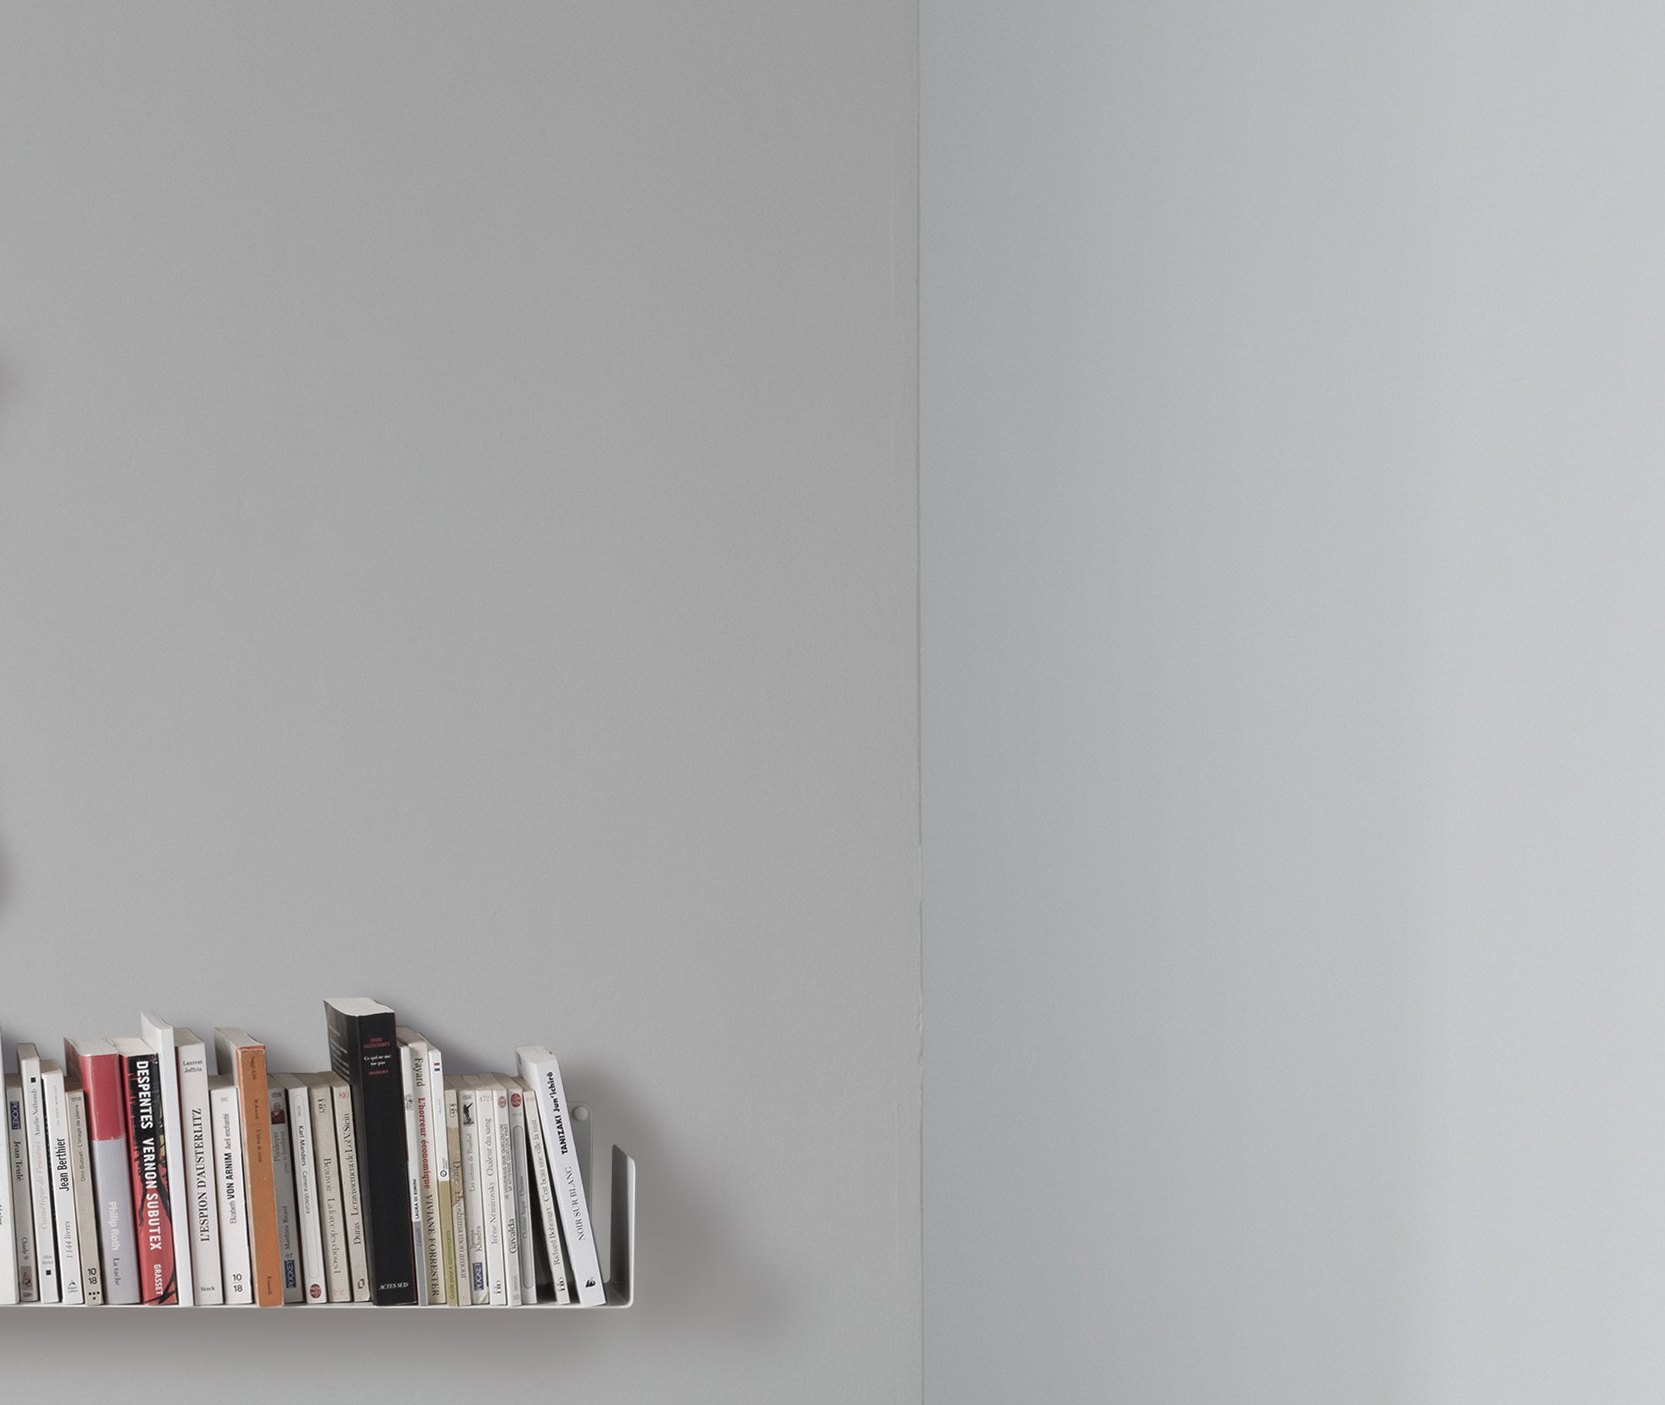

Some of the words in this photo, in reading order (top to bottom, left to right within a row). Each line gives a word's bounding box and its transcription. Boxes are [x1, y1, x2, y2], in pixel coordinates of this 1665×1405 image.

[413, 1057, 426, 1087] Fayard
[136, 1061, 153, 1129] DESPENTES
[417, 1097, 429, 1137] L'horreur
[192, 1108, 206, 1188] D'AUSTERLITZ
[555, 1114, 568, 1155] TANIZAKI
[13, 1141, 21, 1159] Jean
[55, 1137, 69, 1171] Berthier
[143, 1137, 157, 1189] VERNON
[419, 1139, 432, 1190] économique
[224, 1152, 234, 1180] ARNIM
[59, 1172, 70, 1192] Jean
[226, 1182, 235, 1200] VON
[108, 1201, 119, 1227] Philip
[146, 1193, 162, 1251] SUBUTEX
[571, 1198, 580, 1217] SUR
[110, 1228, 120, 1251] Roth
[508, 1218, 518, 1254] Gavalda
[575, 1218, 584, 1241] NOIR
[87, 1268, 97, 1276] 10
[88, 1276, 98, 1285] 18
[153, 1264, 164, 1296] GRASSET
[232, 1273, 243, 1282] 10
[284, 1259, 296, 1288] POCKET
[427, 1238, 440, 1297] FORRESTER
[233, 1284, 243, 1293] 18
